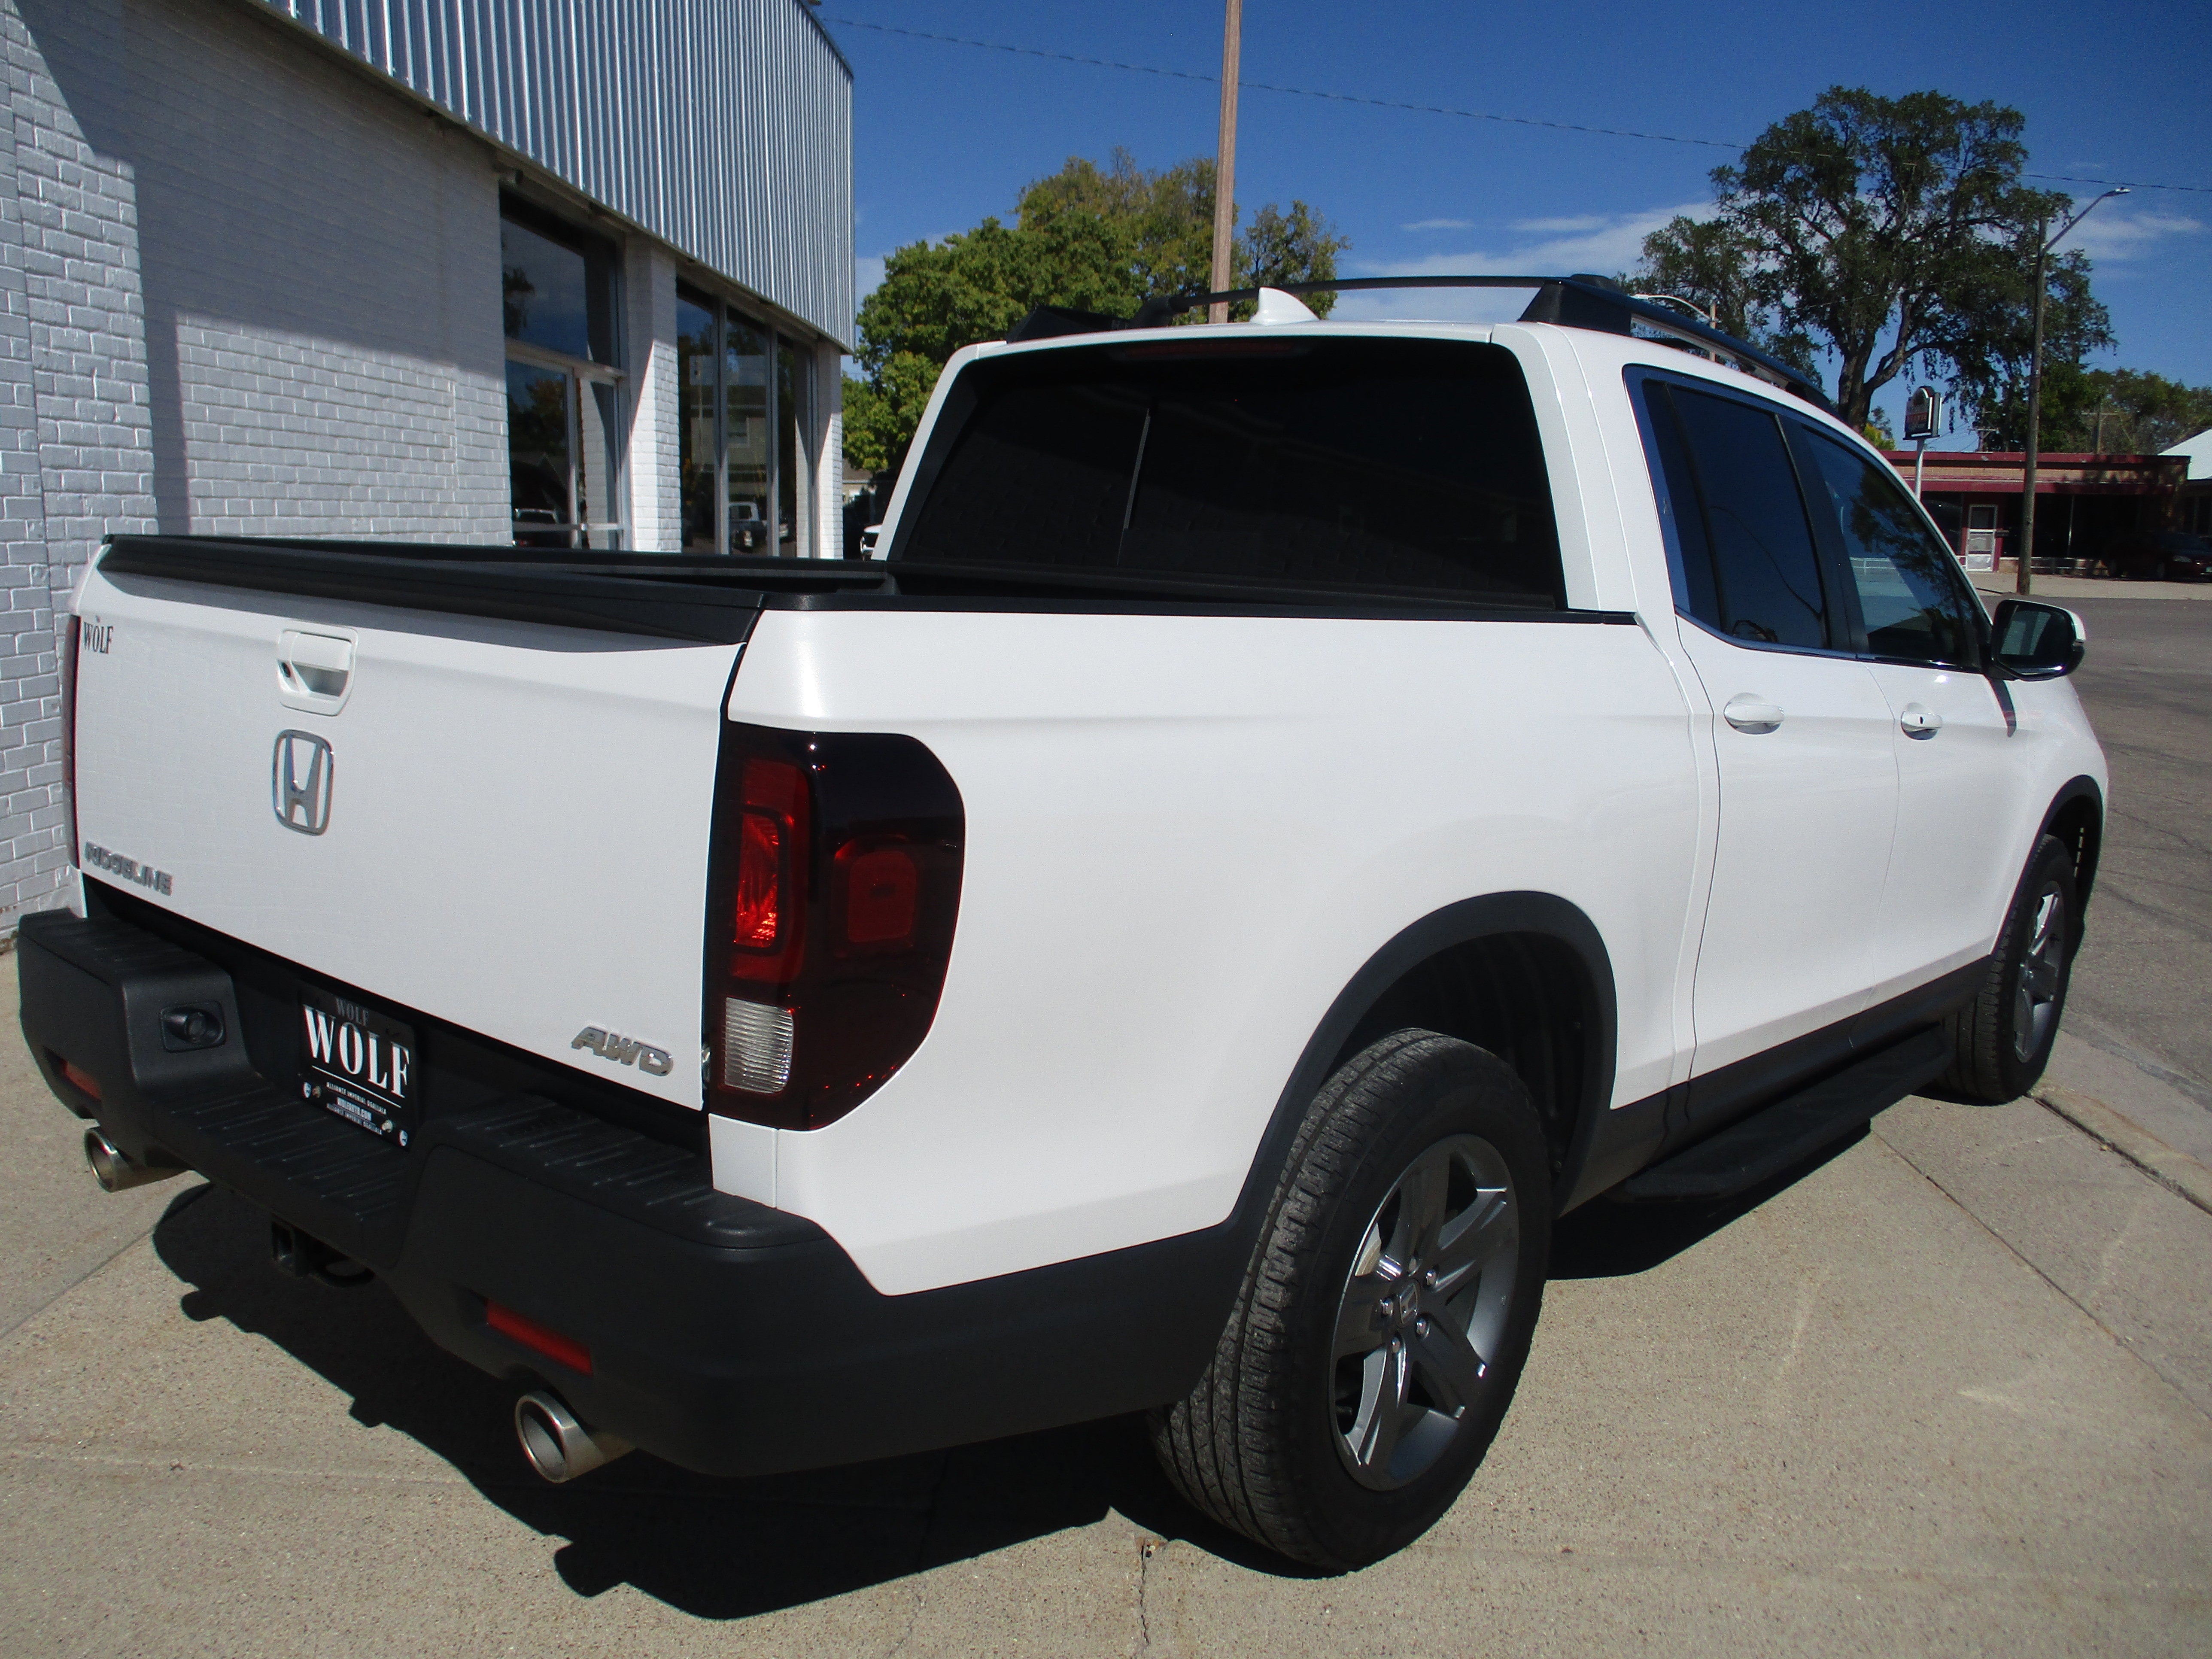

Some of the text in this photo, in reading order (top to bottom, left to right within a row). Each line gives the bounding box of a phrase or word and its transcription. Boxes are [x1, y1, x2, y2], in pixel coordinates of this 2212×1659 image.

[83, 622, 113, 654] WOLF
[85, 842, 173, 896] RIDGELINE
[335, 998, 369, 1026] WOLF
[304, 1005, 409, 1098] WOLF
[571, 1026, 673, 1076] AWD
